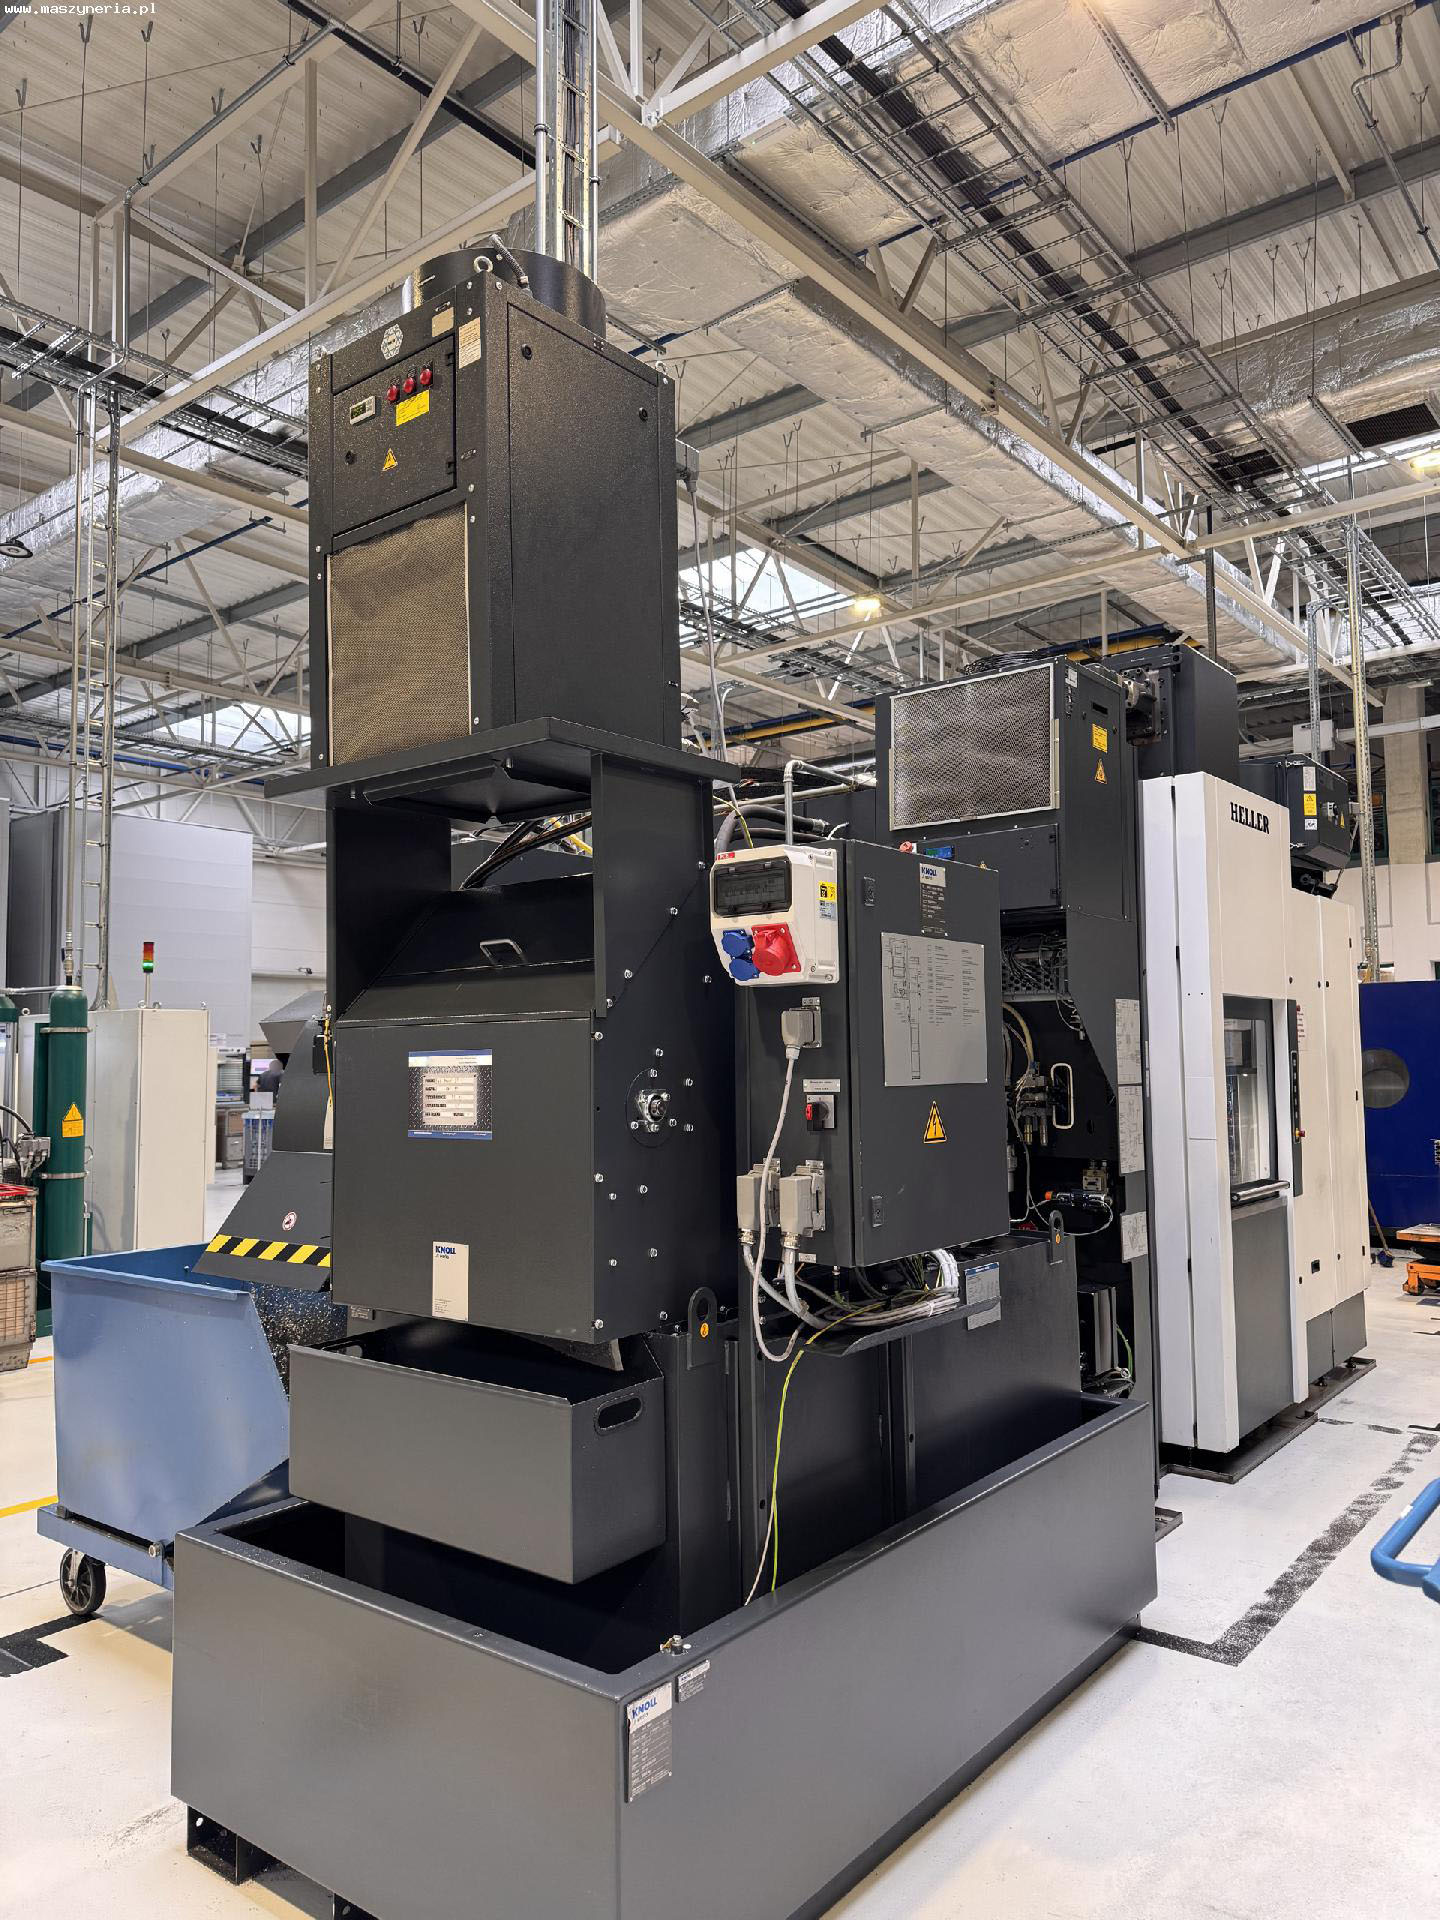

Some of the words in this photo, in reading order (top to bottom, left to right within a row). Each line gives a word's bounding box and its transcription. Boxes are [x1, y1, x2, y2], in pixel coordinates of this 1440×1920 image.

[1230, 801, 1270, 834] HELLER
[435, 1245, 457, 1255] KNOLL
[631, 1696, 657, 1719] KNOLL
